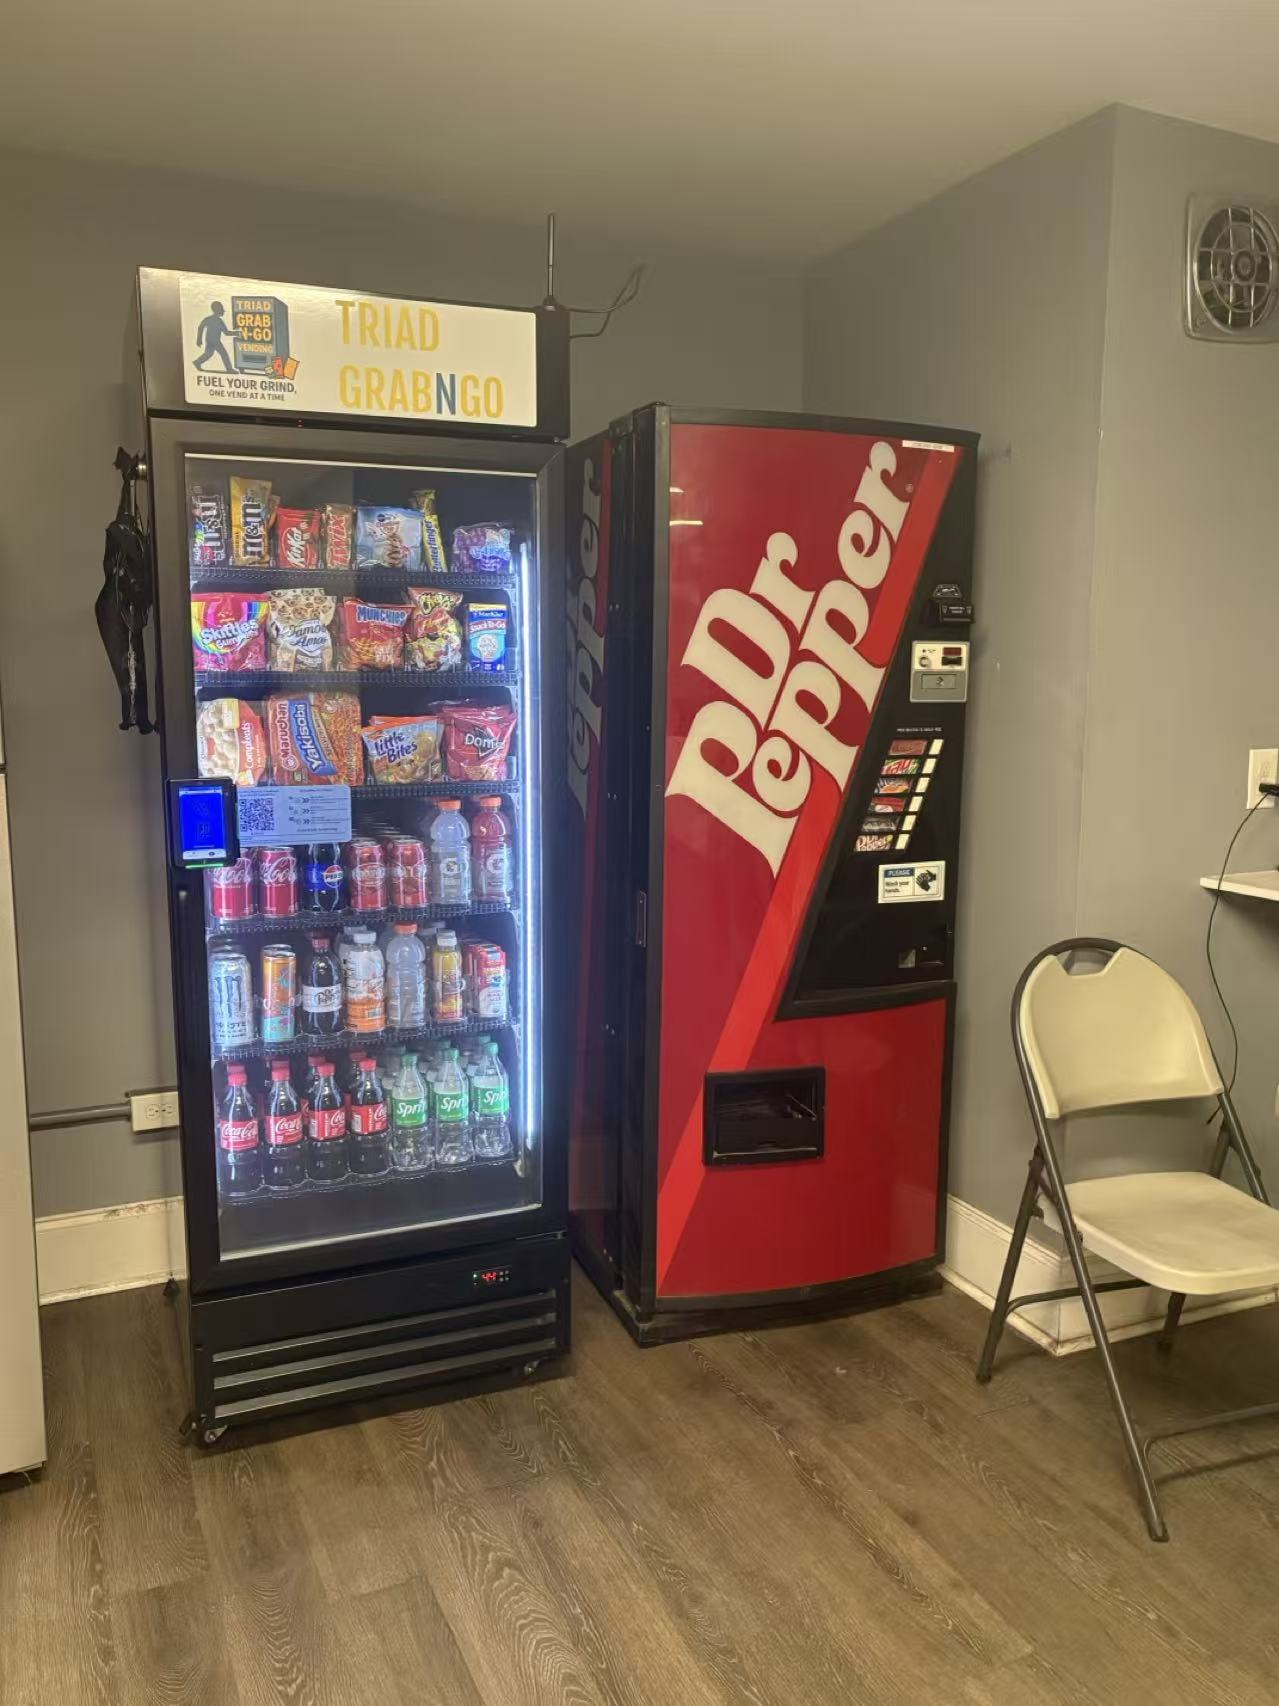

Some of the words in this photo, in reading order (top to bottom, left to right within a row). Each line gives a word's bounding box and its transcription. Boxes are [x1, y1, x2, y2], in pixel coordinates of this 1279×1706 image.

[236, 300, 272, 311] TRIAD
[236, 313, 271, 328] GRAB
[335, 299, 440, 352] TRIAD
[196, 375, 225, 388] FUEL
[227, 377, 258, 390] YOUR
[208, 389, 225, 398] ONE
[226, 390, 248, 399] VEND
[249, 391, 259, 400] AT
[260, 392, 266, 400] A
[267, 393, 285, 402] TIME
[338, 363, 505, 419] GRABNGO
[679, 531, 817, 734] Dr
[664, 440, 911, 880] Pepper
[277, 702, 291, 758] Maruchan
[294, 702, 323, 772] Yakisoba
[374, 731, 405, 757] Little
[386, 741, 418, 764] Bites
